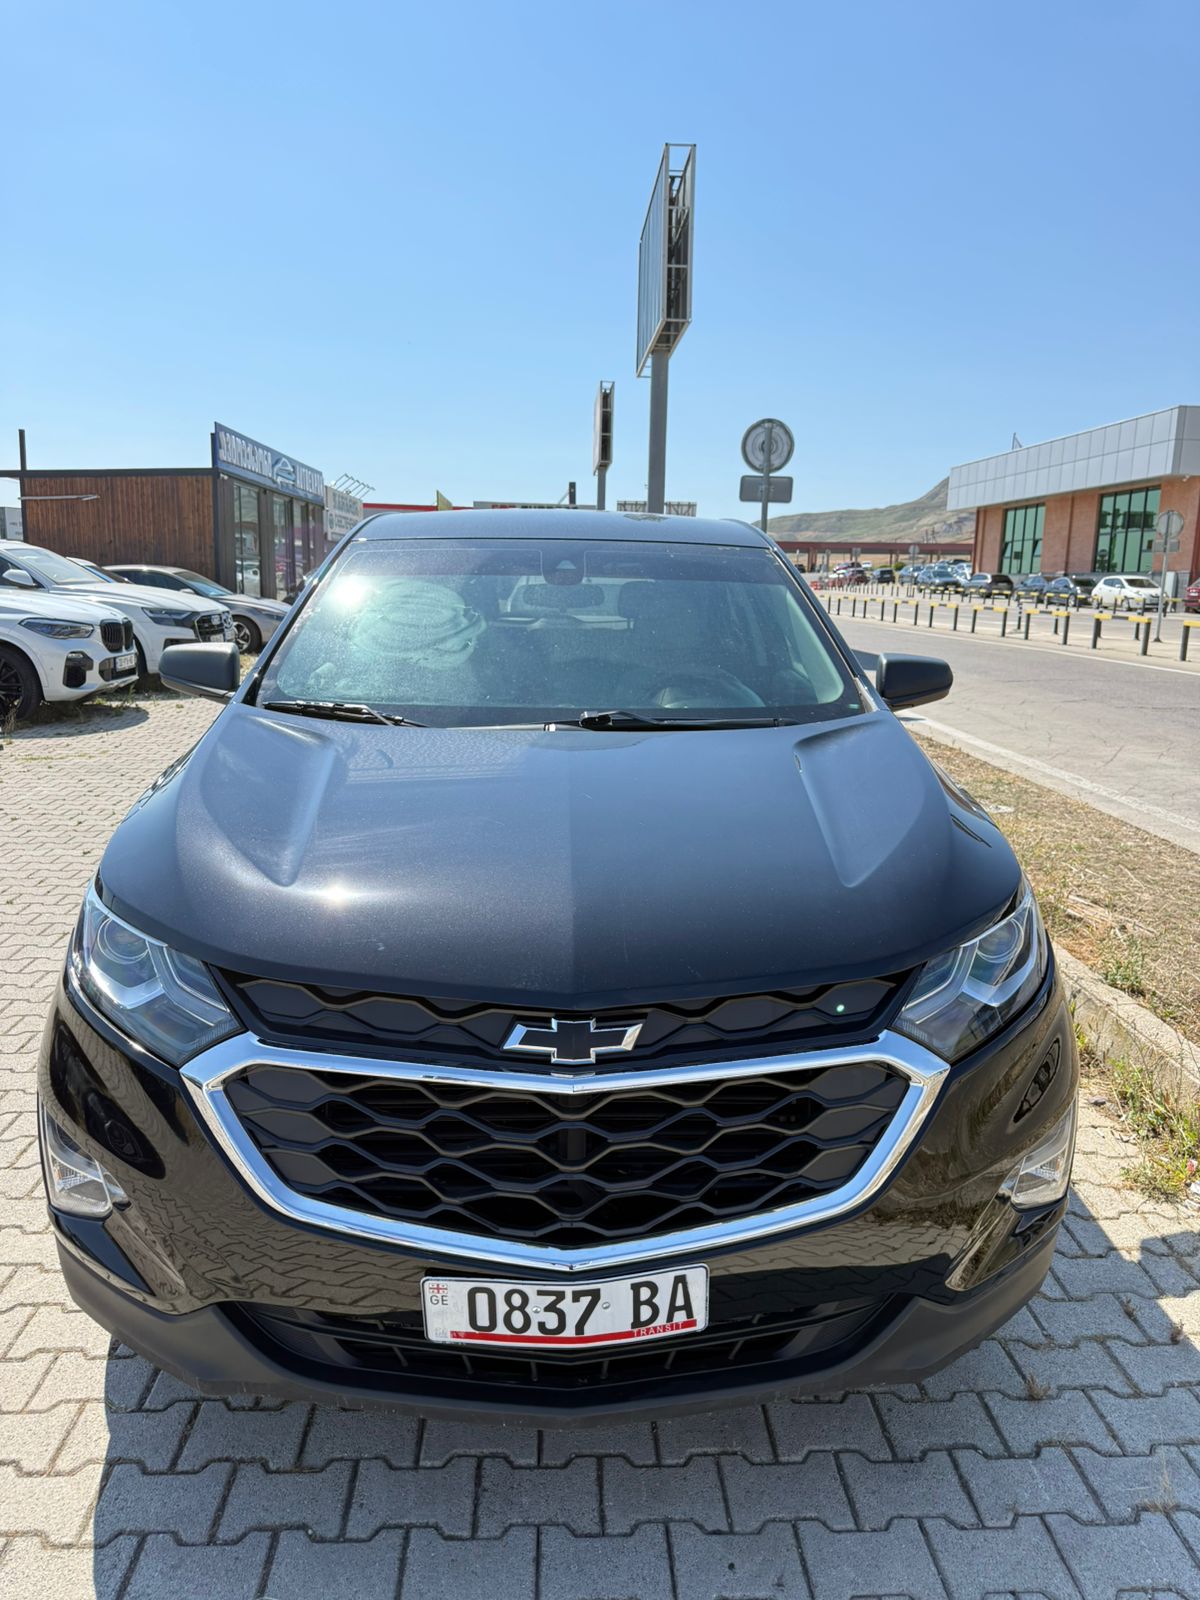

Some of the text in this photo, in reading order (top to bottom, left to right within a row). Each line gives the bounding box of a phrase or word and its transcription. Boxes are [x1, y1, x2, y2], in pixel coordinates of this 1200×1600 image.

[430, 1294, 449, 1306] GE
[467, 1274, 694, 1336] 0837 BA
[632, 1322, 685, 1338] TRANSIT
